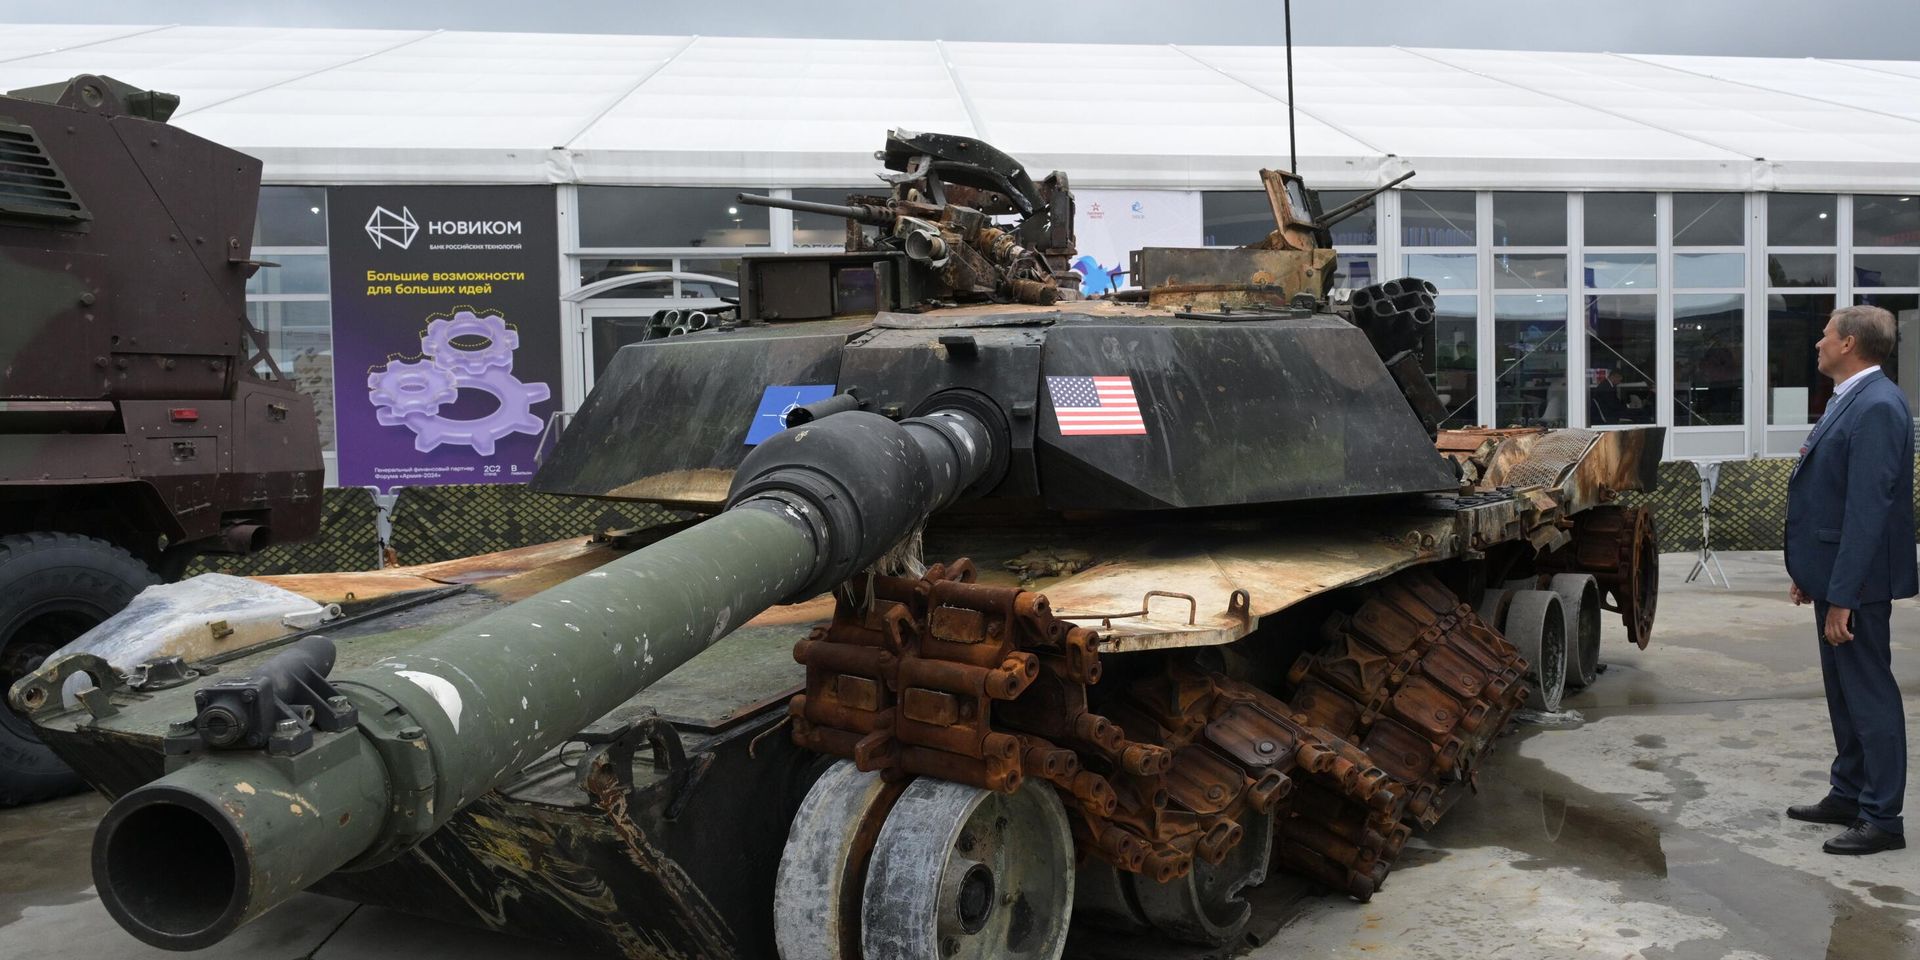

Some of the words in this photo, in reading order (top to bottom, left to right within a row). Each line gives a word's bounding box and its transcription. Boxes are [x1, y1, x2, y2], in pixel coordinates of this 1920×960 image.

[429, 221, 522, 234] НОВИКОМ
[366, 270, 429, 281] Большие
[432, 272, 525, 281] возможности
[366, 285, 392, 296] для
[395, 284, 455, 294] больших
[459, 283, 492, 295] идей
